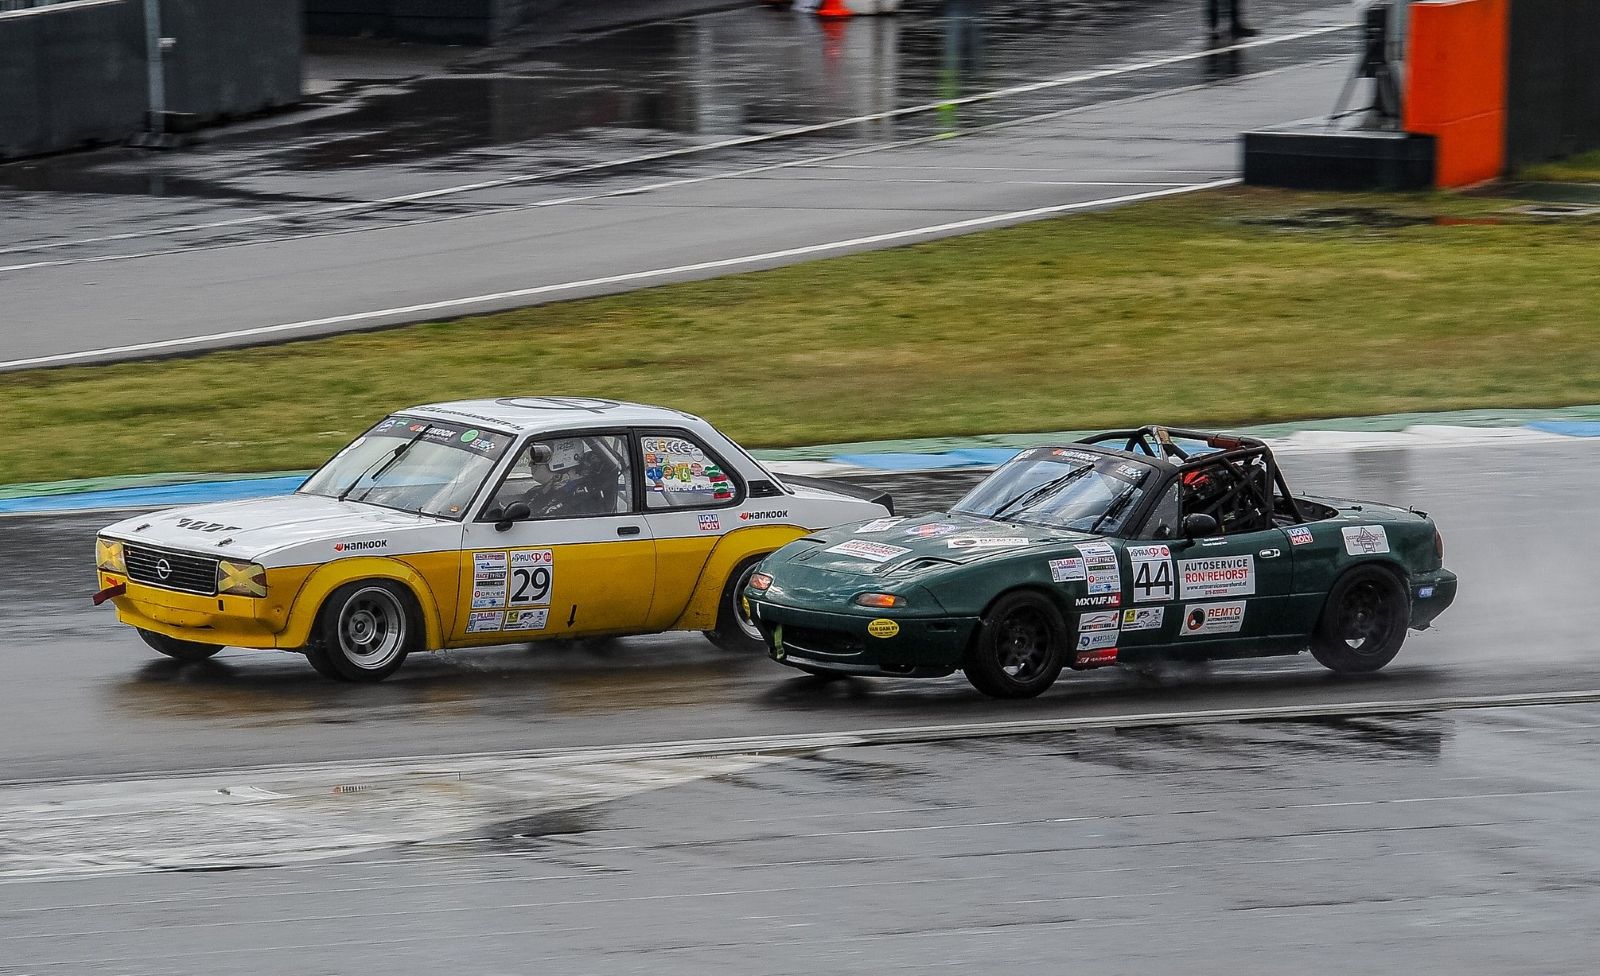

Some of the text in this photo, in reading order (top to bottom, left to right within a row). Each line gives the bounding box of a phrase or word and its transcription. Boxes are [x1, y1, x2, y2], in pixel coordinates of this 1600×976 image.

[699, 514, 718, 523] LIQUI
[699, 522, 720, 531] MOLY
[1291, 534, 1313, 545] MOLY
[1184, 558, 1248, 572] AUTOSERVICE
[1134, 561, 1173, 597] 44
[1185, 568, 1248, 583] RON REHORST
[511, 567, 550, 602] 29
[1208, 606, 1241, 618] REMTO
